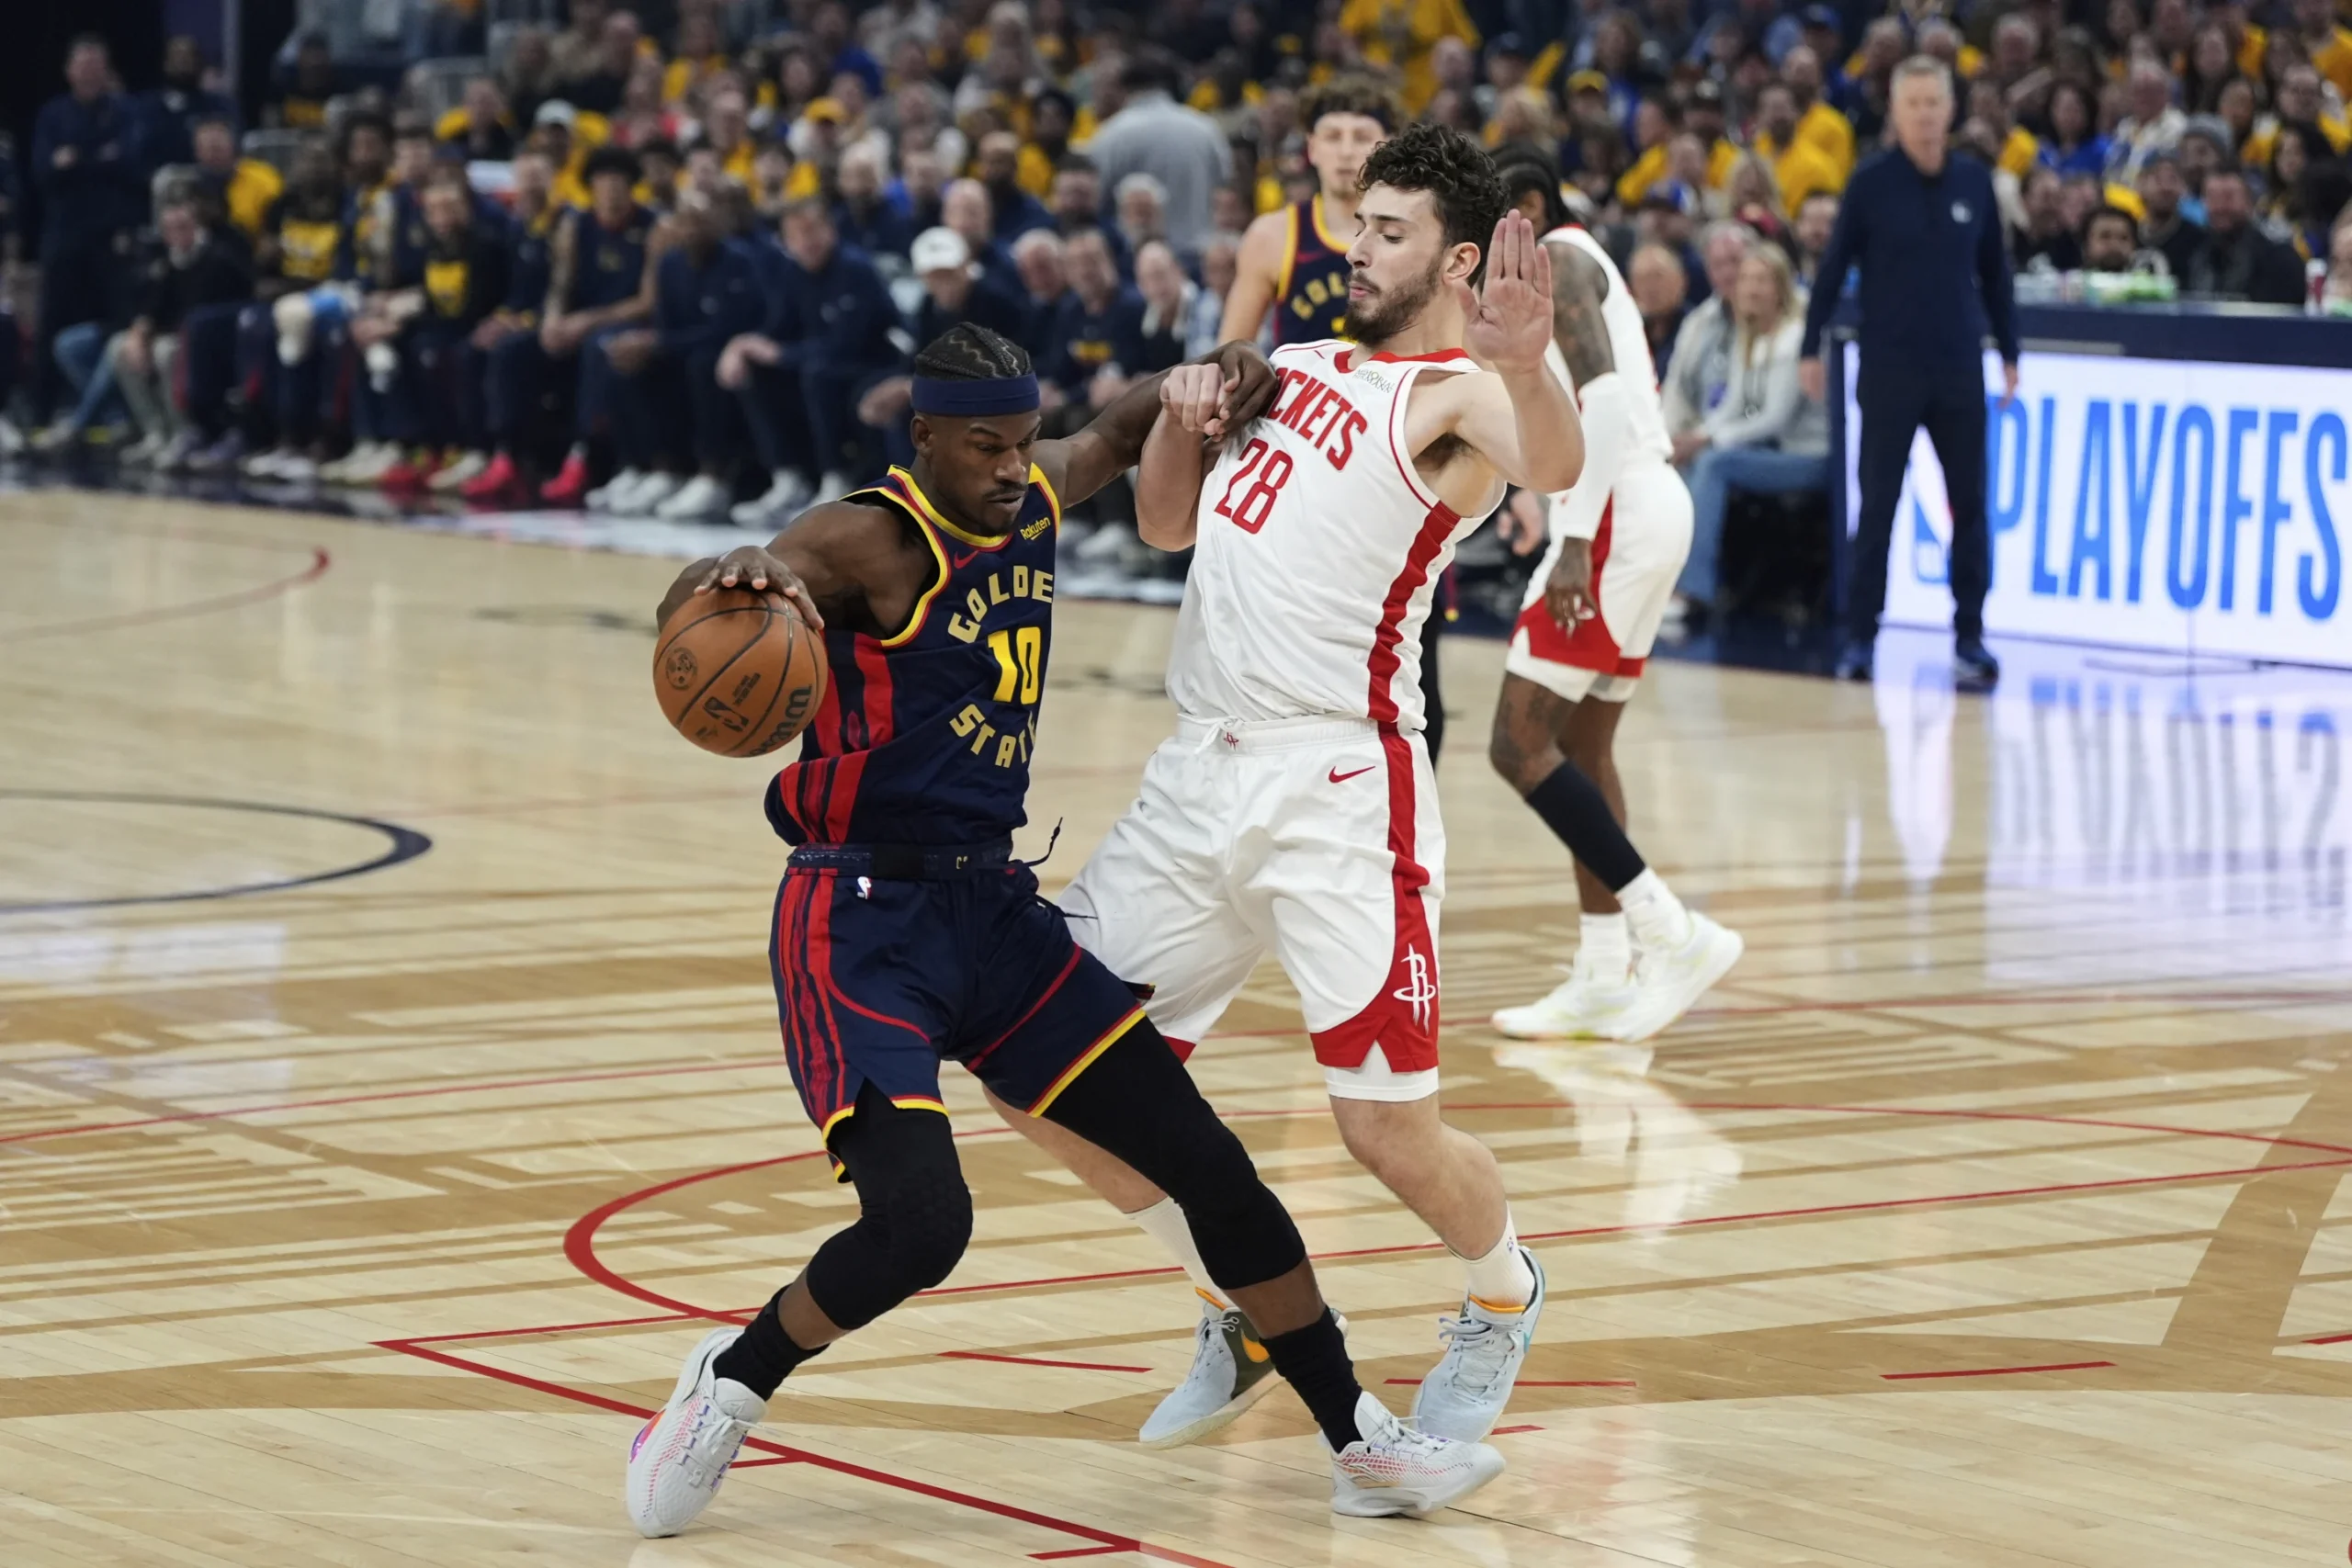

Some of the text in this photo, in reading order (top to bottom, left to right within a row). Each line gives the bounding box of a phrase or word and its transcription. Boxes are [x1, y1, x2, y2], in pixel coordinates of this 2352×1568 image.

[1020, 517, 1051, 540] Rakuten
[1214, 437, 1294, 535] 28
[1986, 394, 2347, 621] PLAYOFFS
[988, 626, 1041, 705] 10
